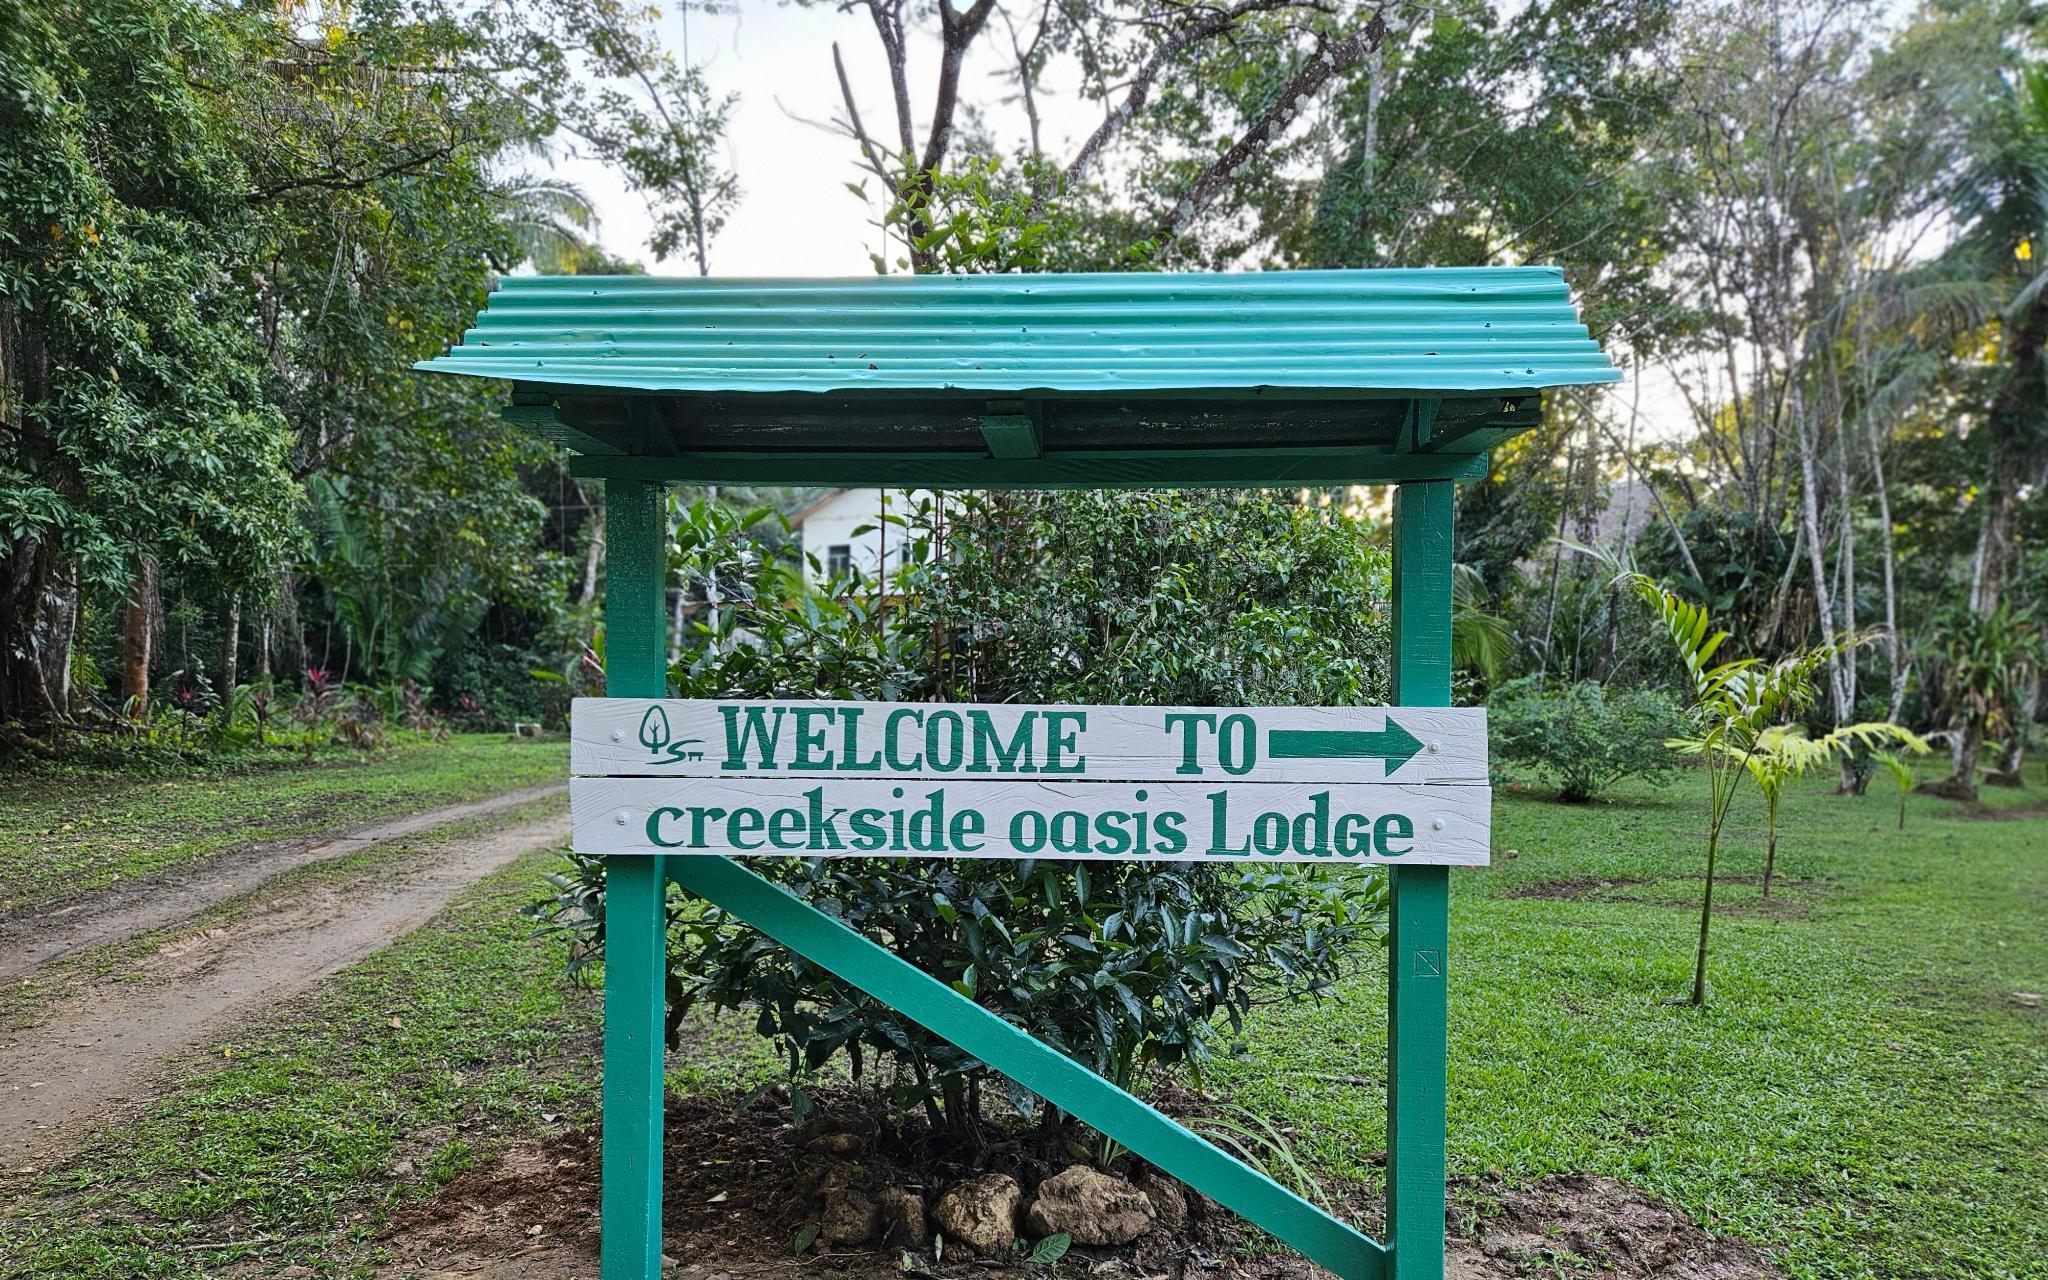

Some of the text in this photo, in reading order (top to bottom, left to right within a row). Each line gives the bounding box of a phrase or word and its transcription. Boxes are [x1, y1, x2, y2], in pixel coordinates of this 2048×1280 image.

[718, 705, 1257, 776] WELCOME TO
[645, 786, 985, 852] creekside
[1009, 789, 1188, 856] oasis
